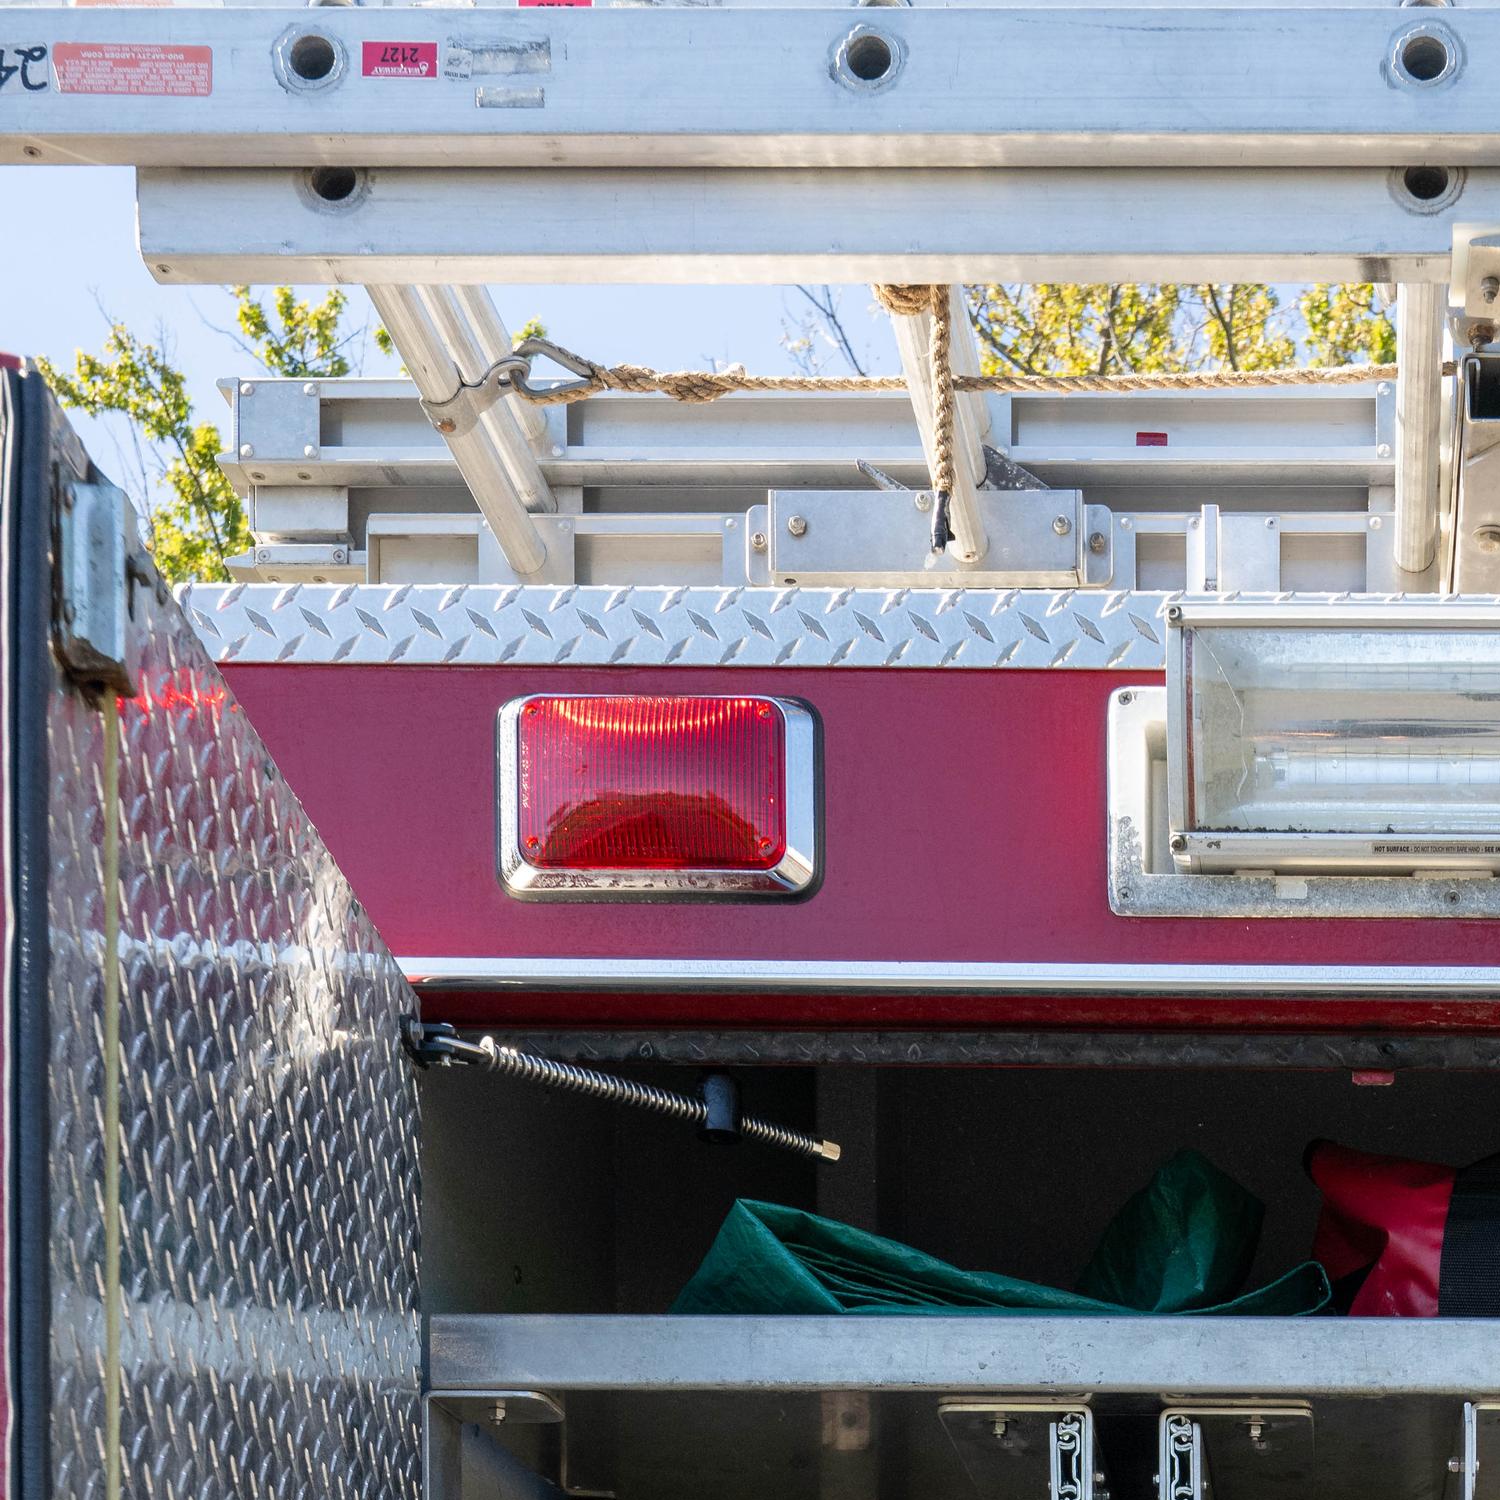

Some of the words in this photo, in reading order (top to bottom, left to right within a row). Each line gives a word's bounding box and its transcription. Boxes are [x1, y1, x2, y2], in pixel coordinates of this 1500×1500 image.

[104, 52, 136, 60] LADDER
[137, 53, 184, 61] DUO-SAFETY
[380, 48, 419, 62] 2127
[371, 67, 420, 76] WATERWAY
